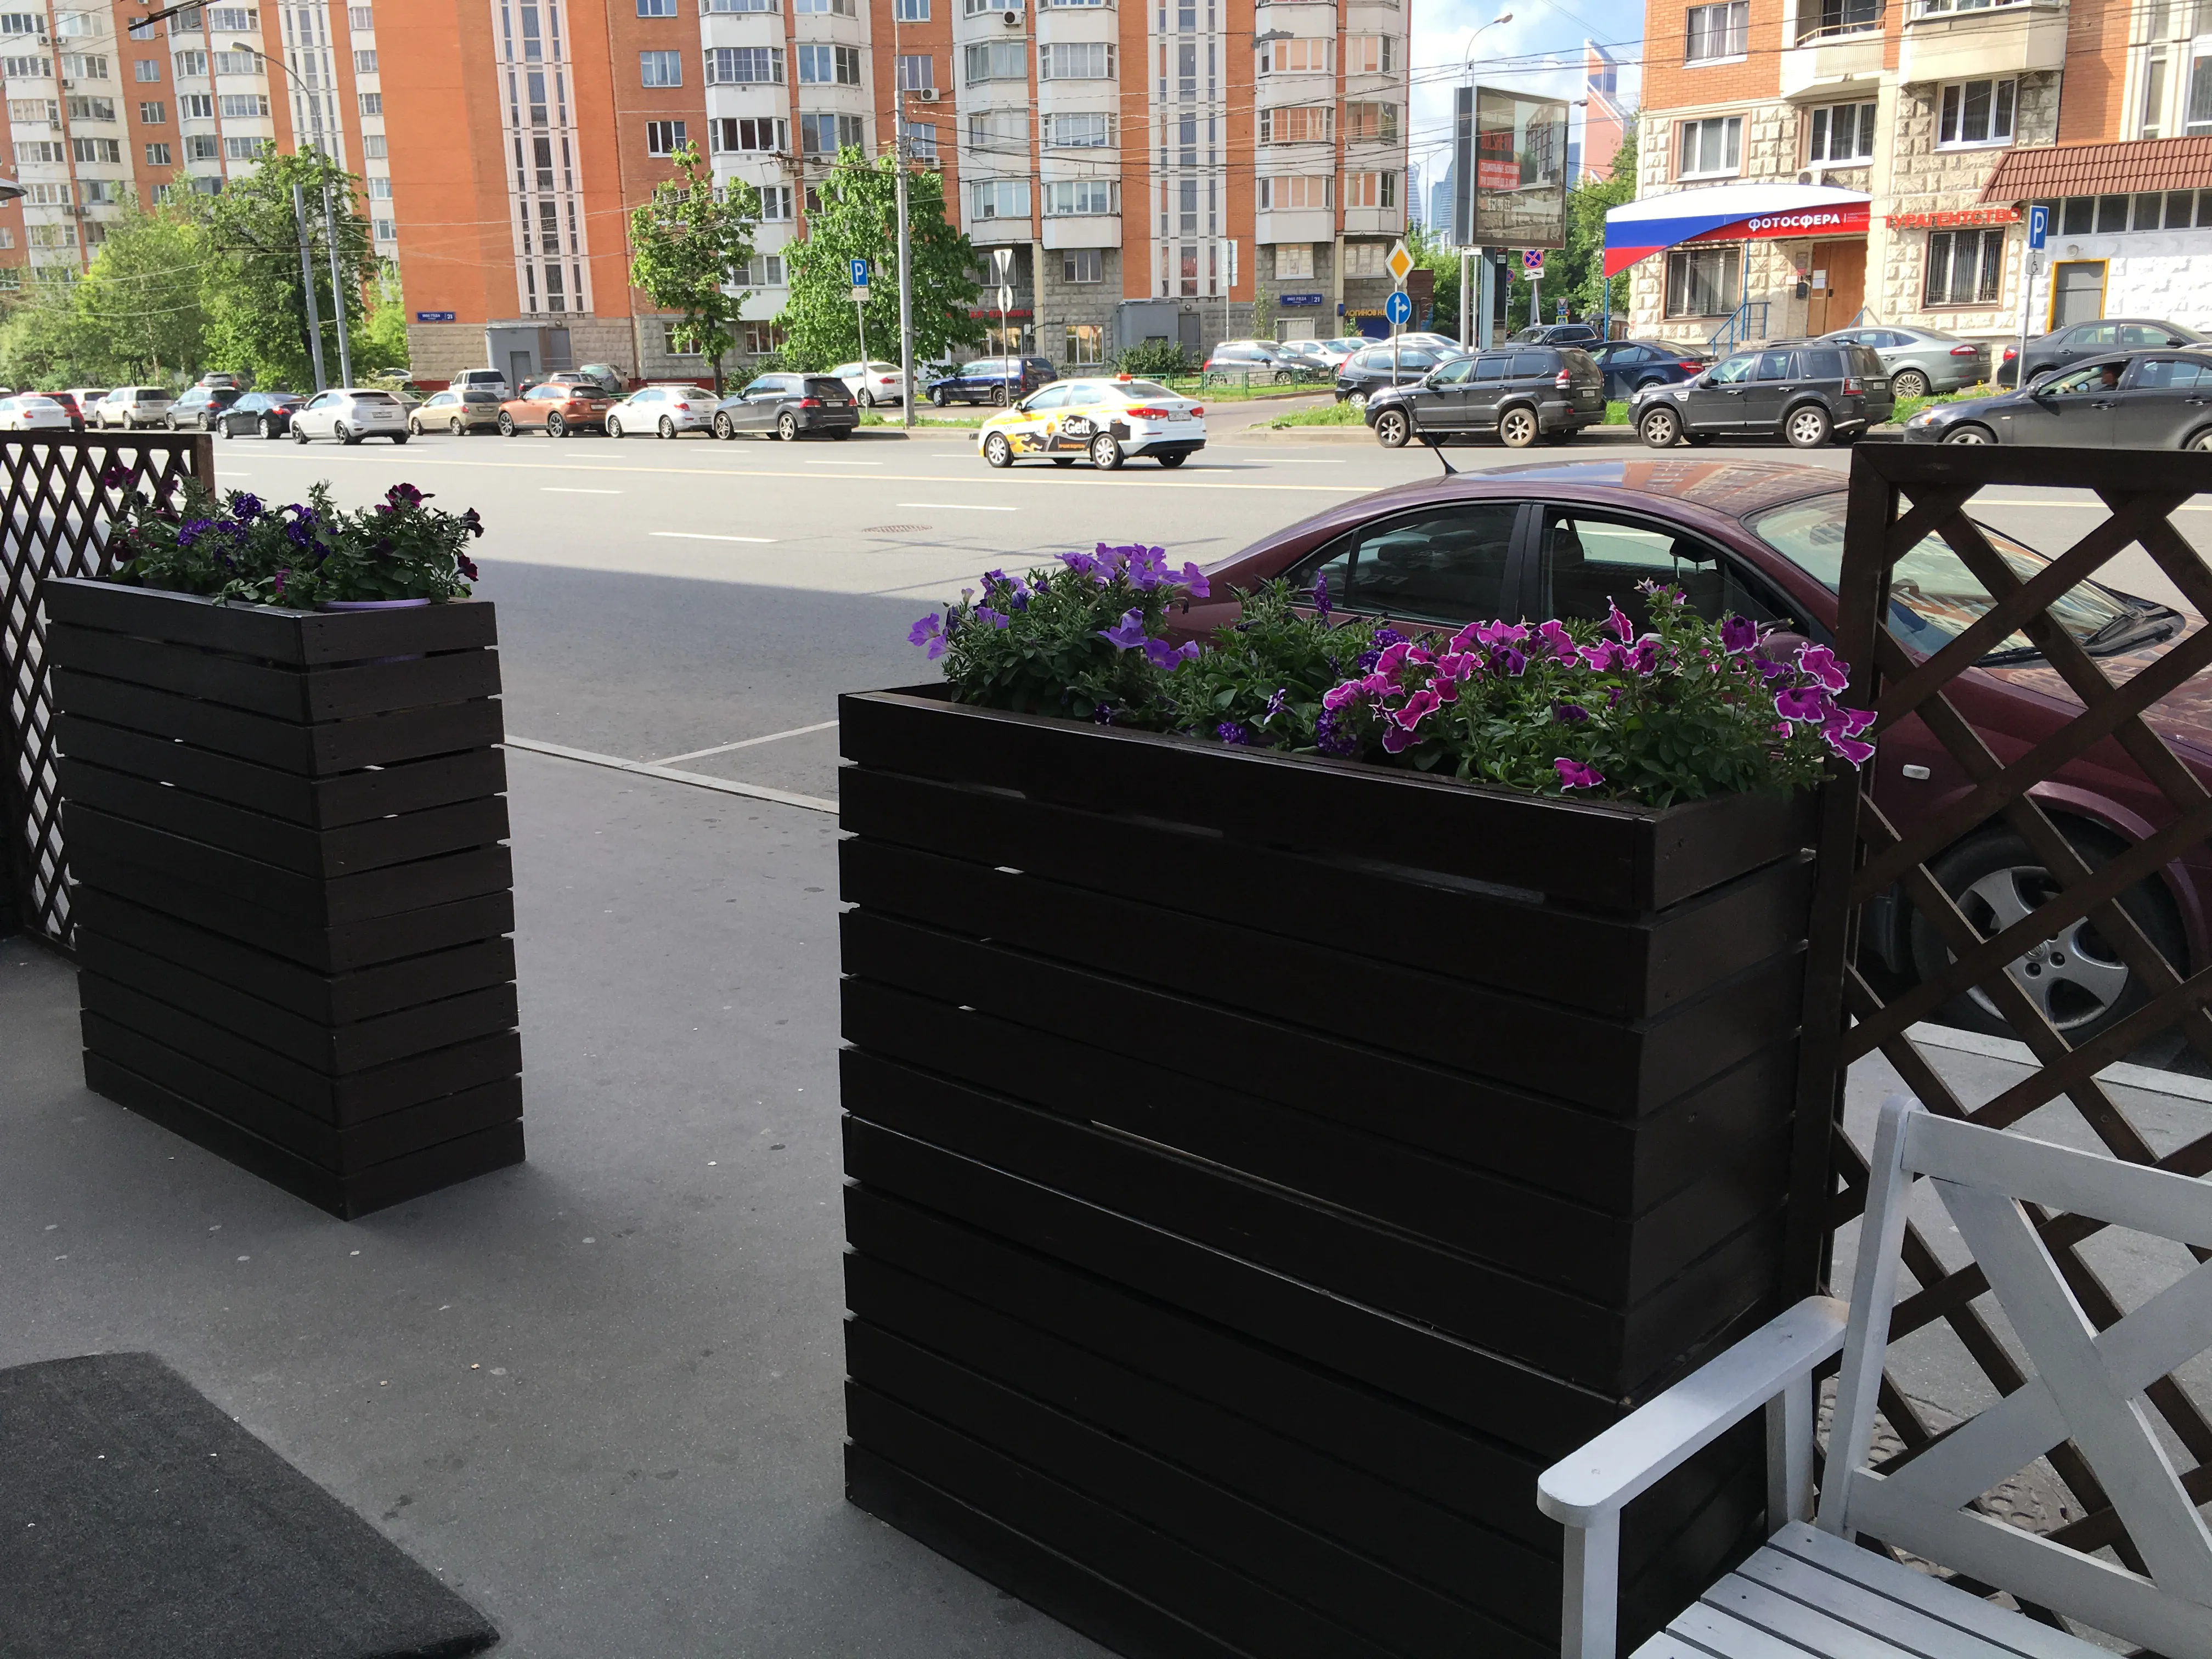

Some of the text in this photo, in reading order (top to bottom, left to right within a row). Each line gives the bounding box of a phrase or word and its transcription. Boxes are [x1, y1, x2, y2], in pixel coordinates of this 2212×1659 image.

[1748, 213, 1840, 232] ФОТОСФЕРА
[1883, 207, 2021, 228] ТУРАГЕНТСТВО
[989, 309, 1032, 318] КЛНИКА
[1065, 419, 1091, 434] Gett
